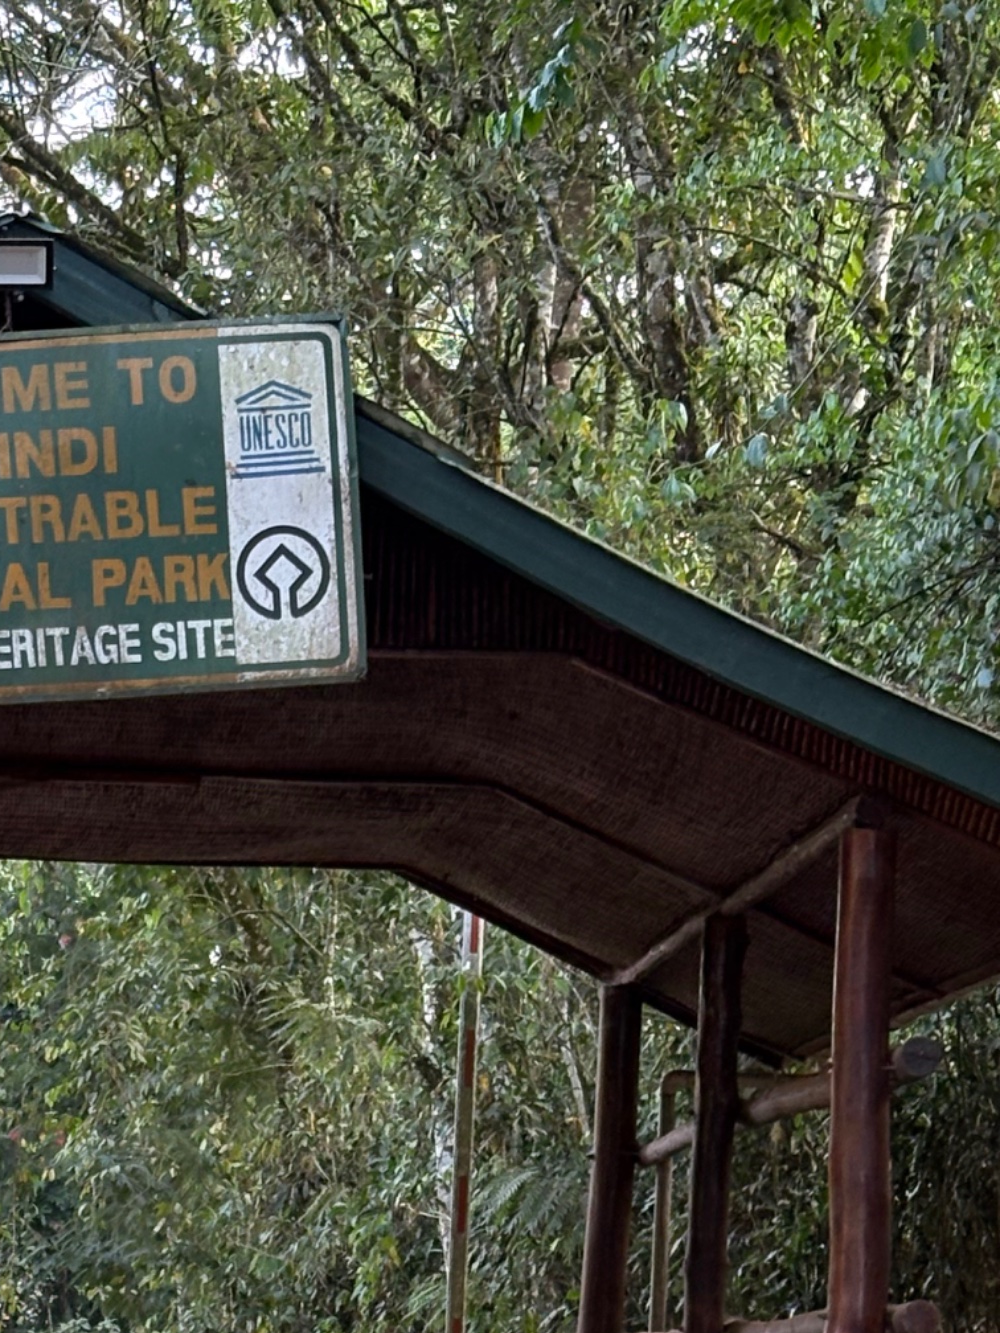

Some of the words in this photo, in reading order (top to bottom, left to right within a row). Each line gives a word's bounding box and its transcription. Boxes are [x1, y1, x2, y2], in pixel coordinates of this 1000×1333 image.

[117, 355, 197, 406] TO
[239, 411, 313, 452] UNESCO
[92, 553, 230, 608] PARK
[151, 618, 237, 662] SITE
